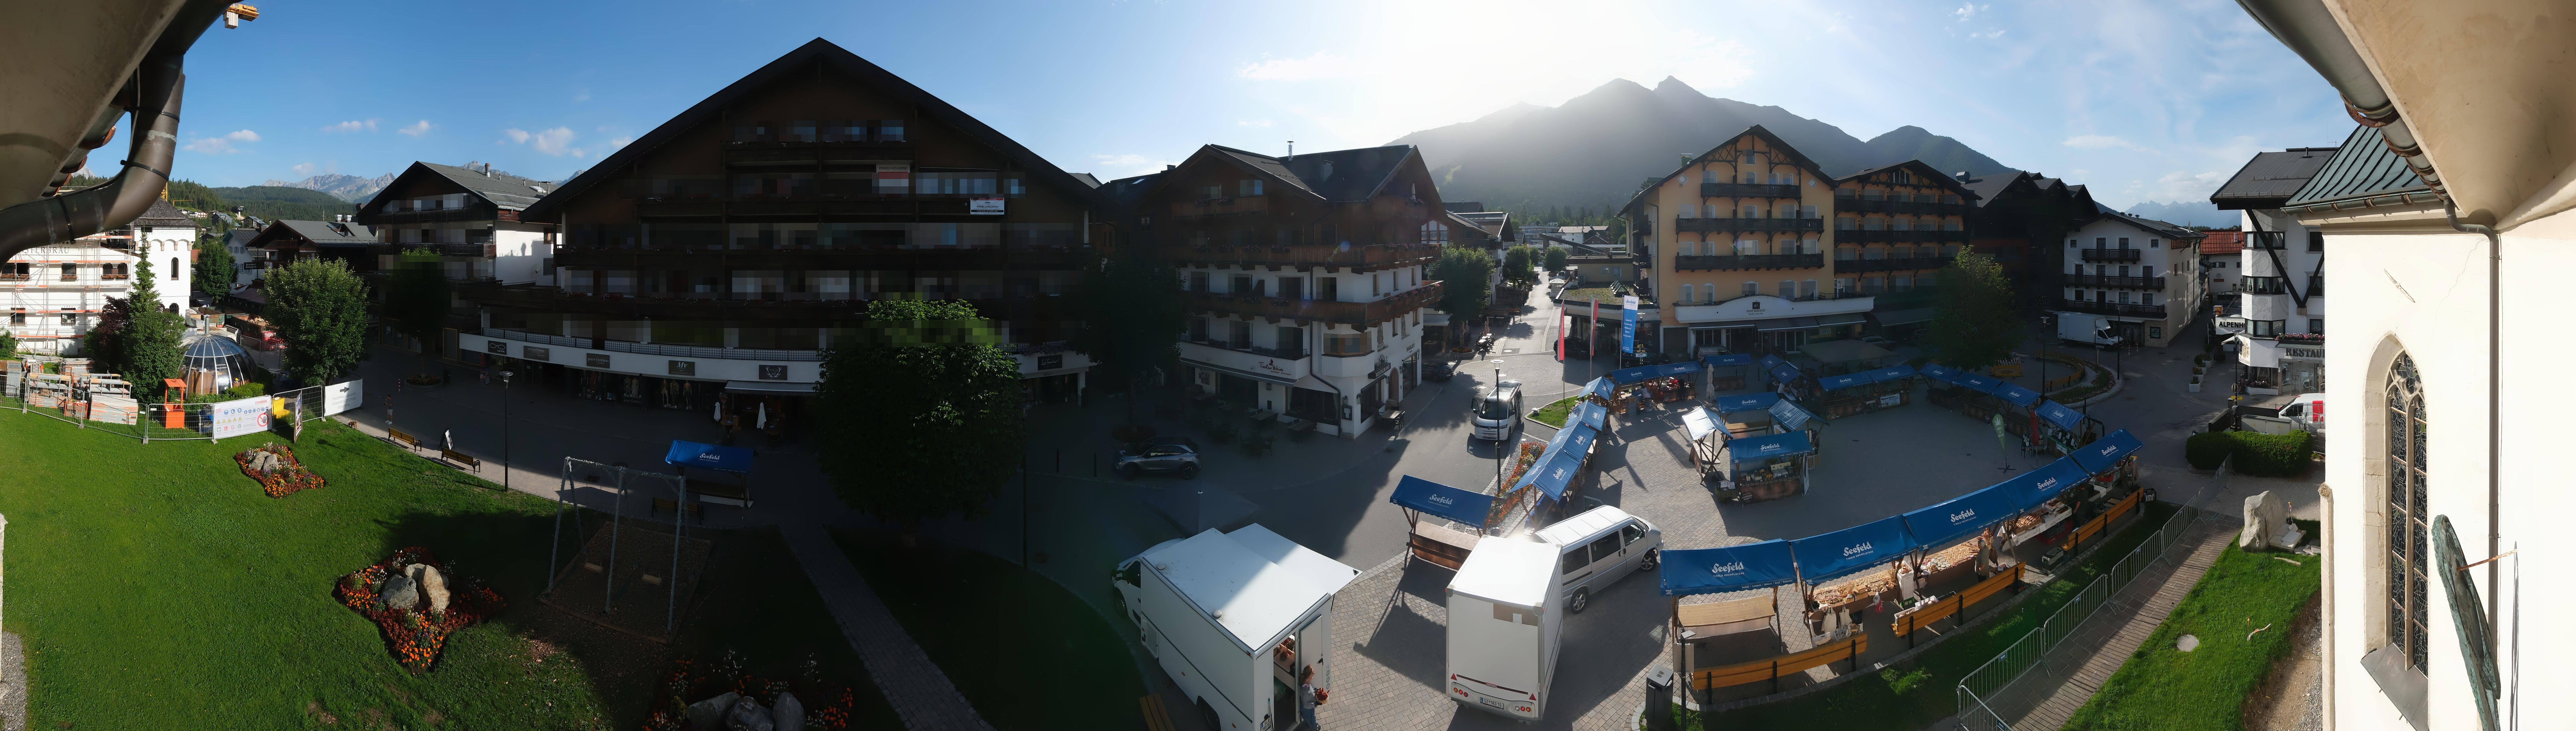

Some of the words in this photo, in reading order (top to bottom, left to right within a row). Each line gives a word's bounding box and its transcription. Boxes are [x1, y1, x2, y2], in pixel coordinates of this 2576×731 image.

[1376, 364, 1390, 377] RESTAURANT
[332, 397, 356, 405] KONGRESSZENTRUM
[2102, 445, 2116, 455] Seefeld
[1553, 467, 1564, 479] Seefeld
[2037, 477, 2056, 489] Seefeld
[1429, 494, 1453, 505] Seefeld
[1951, 508, 1975, 522] Seefeld
[1843, 541, 1872, 556] Seefeld
[1711, 561, 1744, 573] Seefeld
